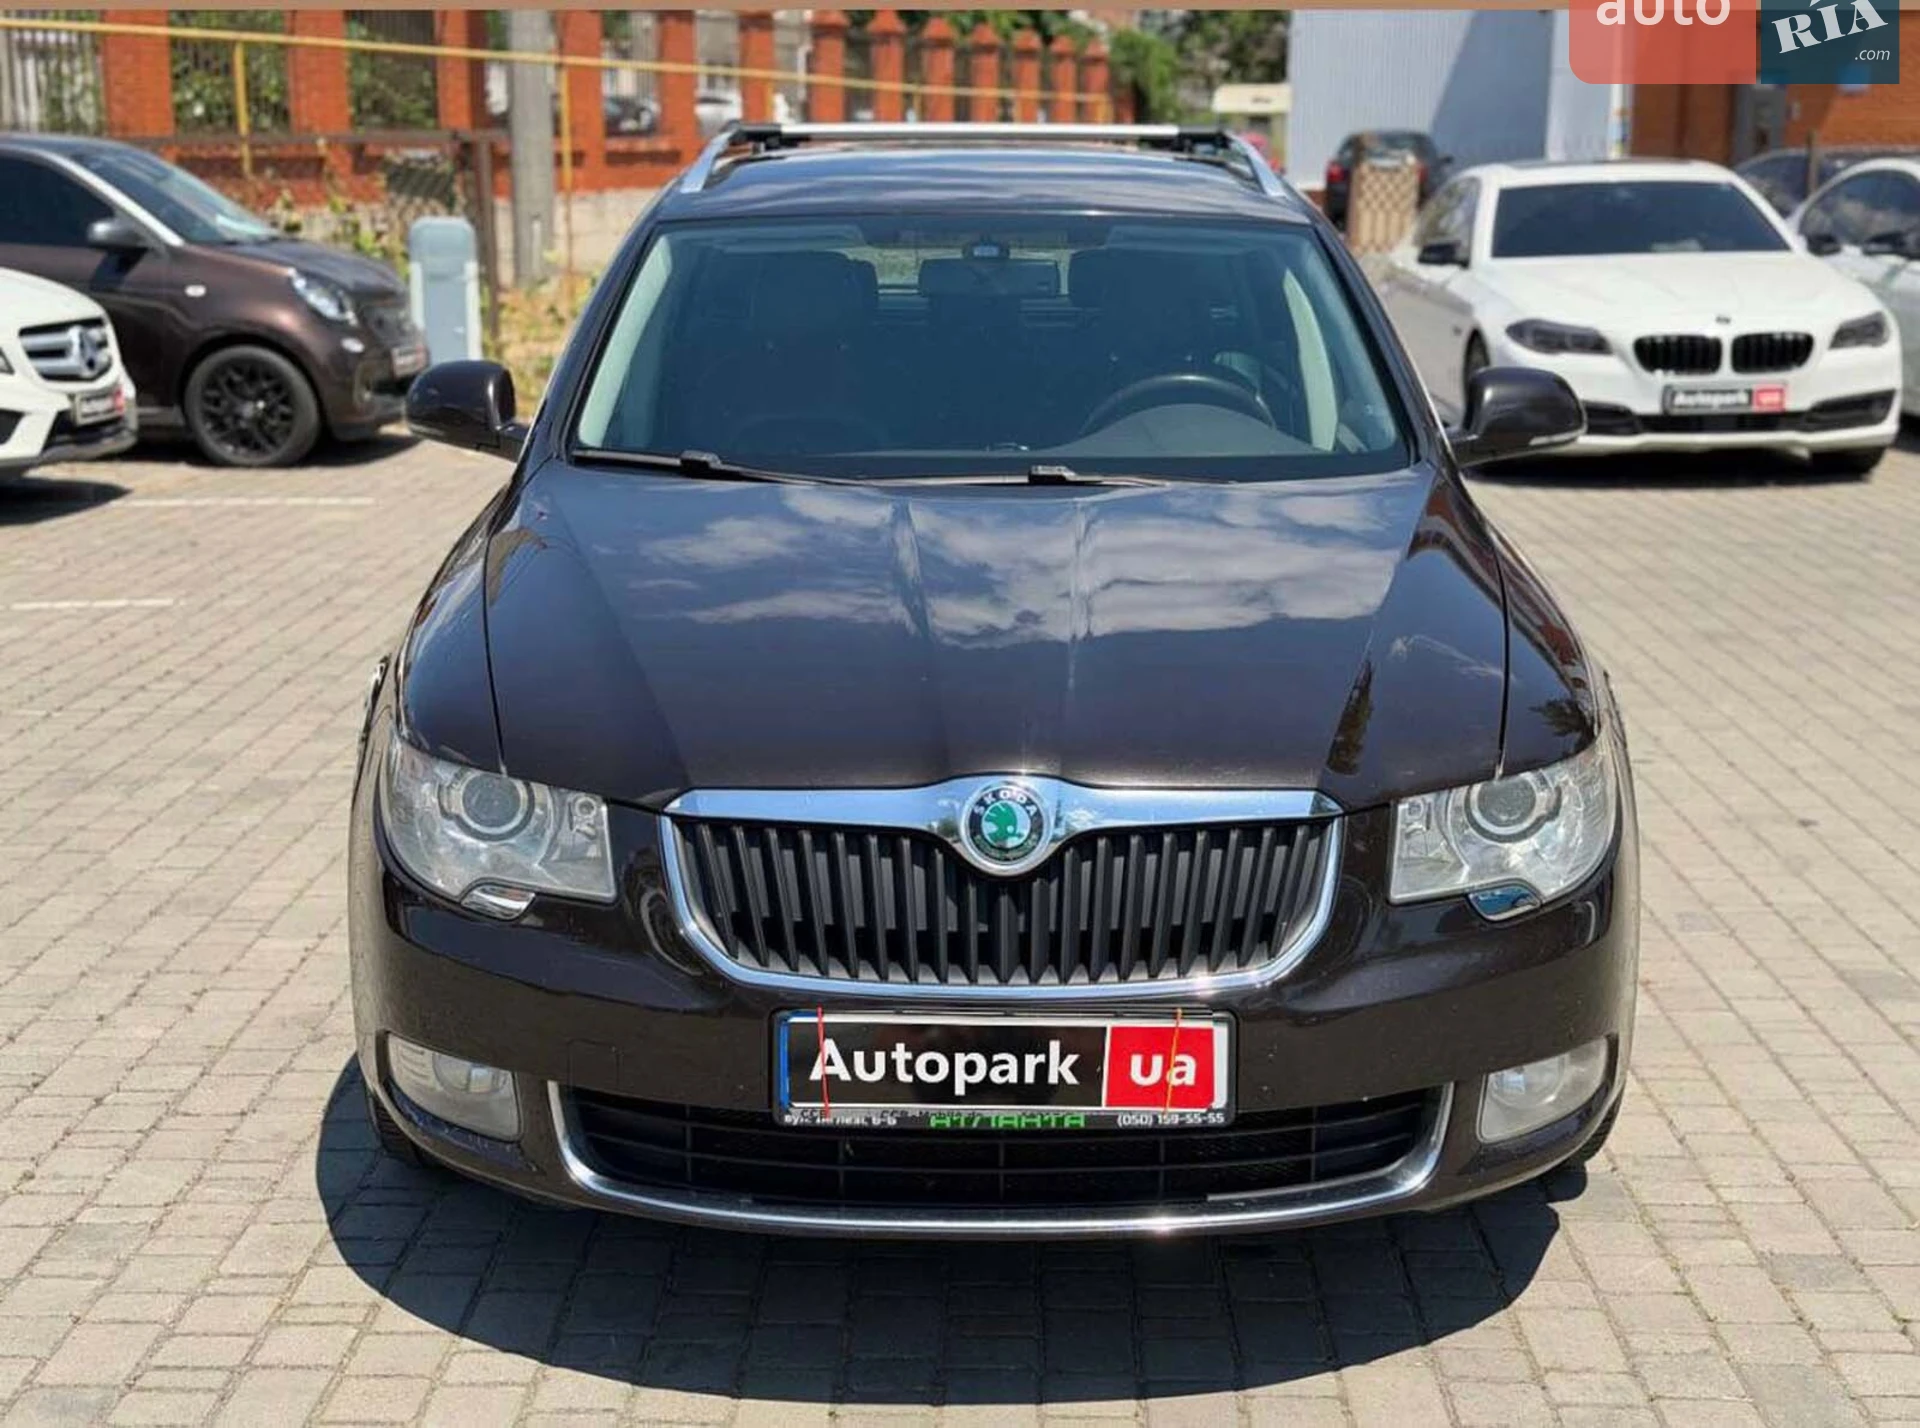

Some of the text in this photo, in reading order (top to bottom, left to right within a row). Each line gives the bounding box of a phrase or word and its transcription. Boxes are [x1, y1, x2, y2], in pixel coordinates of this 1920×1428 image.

[809, 1037, 1198, 1096] Autopark ua
[1117, 1113, 1154, 1128] (050)
